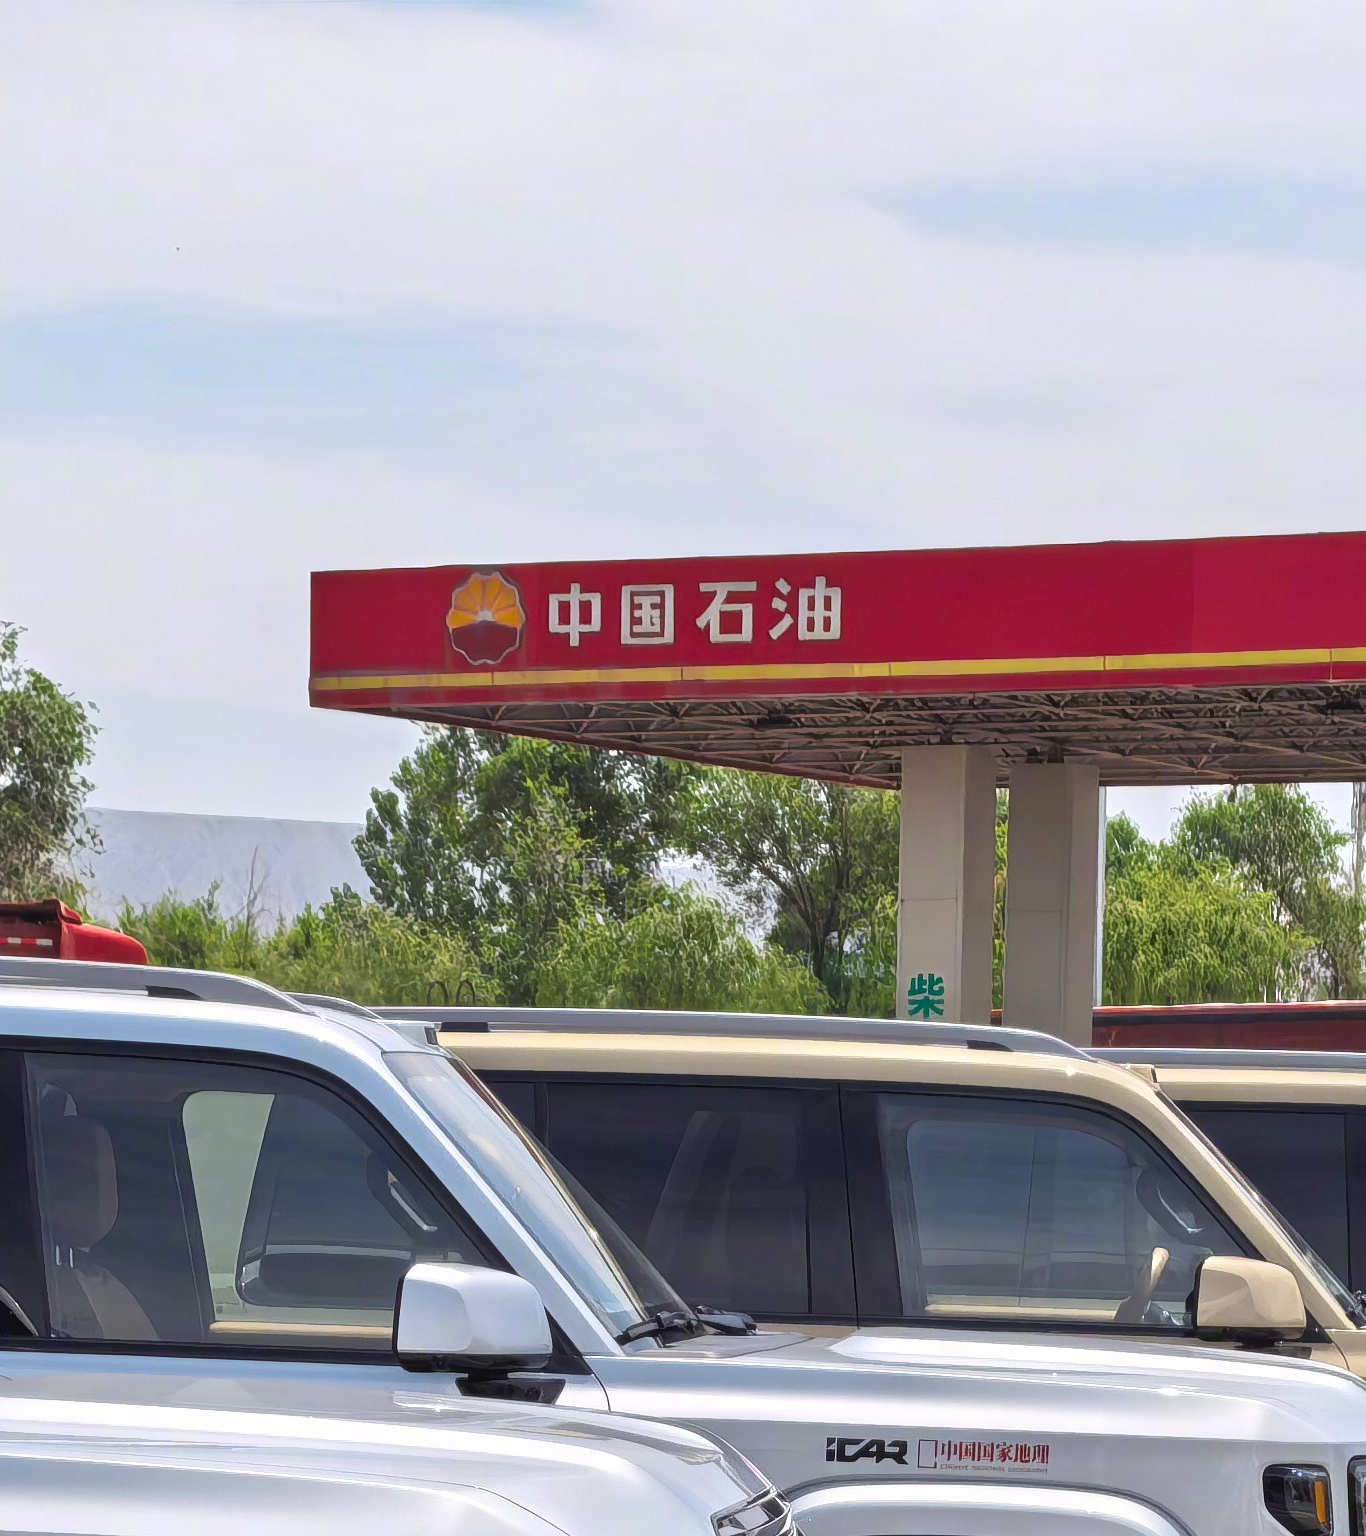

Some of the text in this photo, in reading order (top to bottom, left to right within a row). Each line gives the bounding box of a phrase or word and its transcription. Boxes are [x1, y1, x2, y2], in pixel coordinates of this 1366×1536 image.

[549, 576, 842, 647] 中国石油
[907, 972, 945, 1019] 柴
[941, 1440, 1050, 1464] 中国国家地理
